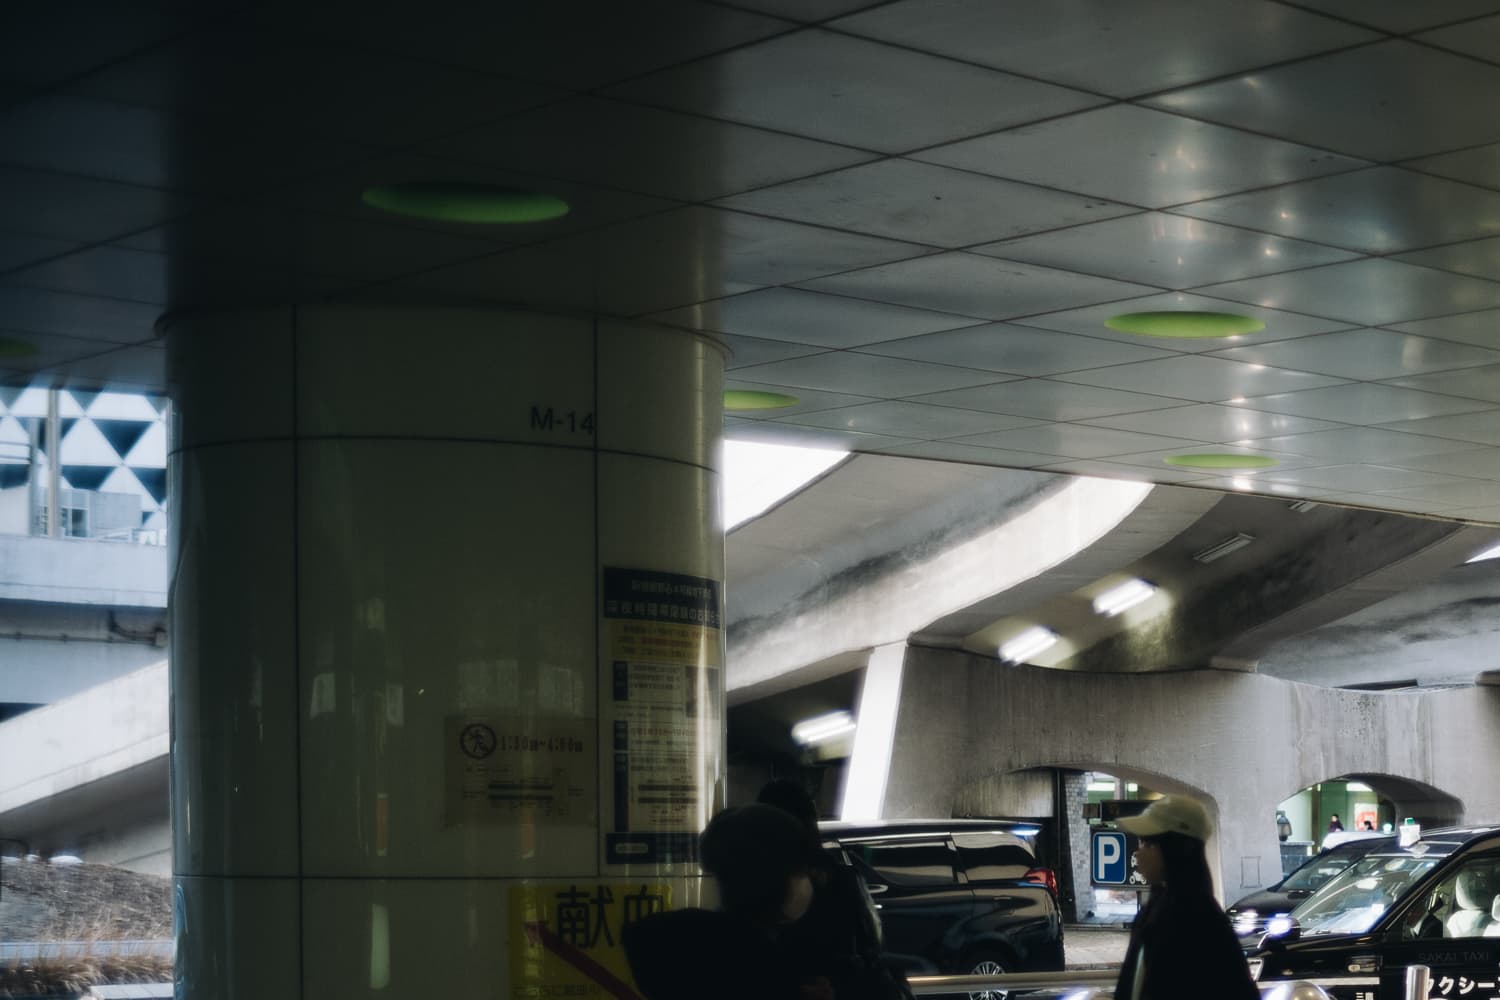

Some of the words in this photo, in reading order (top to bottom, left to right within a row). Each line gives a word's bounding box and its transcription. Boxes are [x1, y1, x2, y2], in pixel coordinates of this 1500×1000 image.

[530, 406, 594, 435] M-14
[1098, 836, 1120, 880] P
[1418, 952, 1457, 962] SAKAI
[1463, 951, 1489, 961] TAXI
